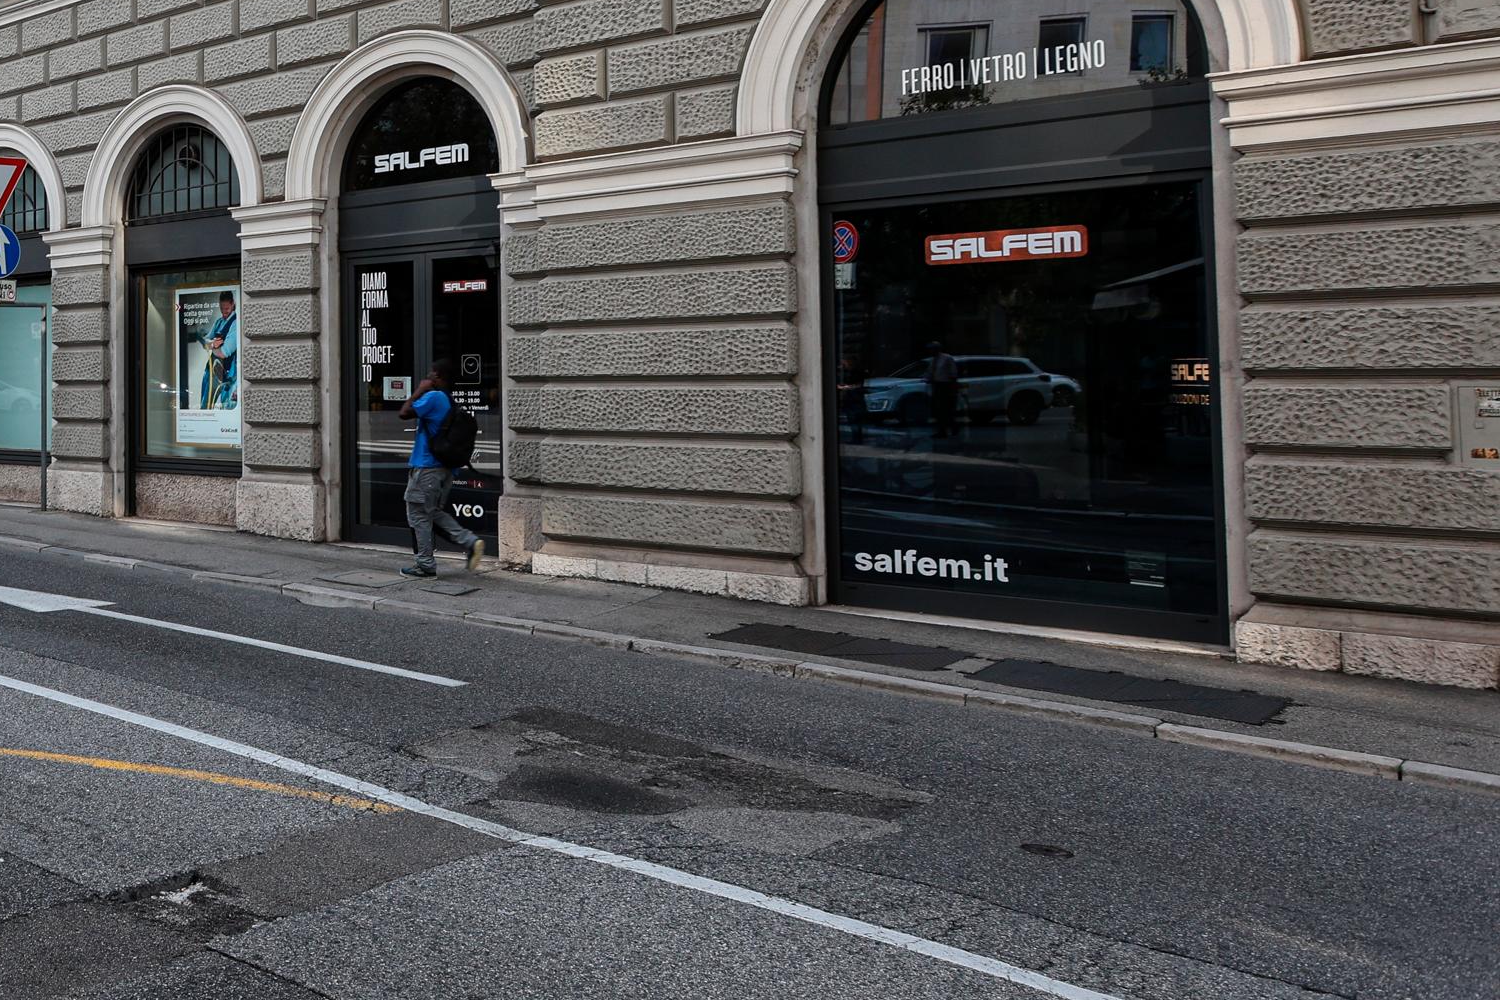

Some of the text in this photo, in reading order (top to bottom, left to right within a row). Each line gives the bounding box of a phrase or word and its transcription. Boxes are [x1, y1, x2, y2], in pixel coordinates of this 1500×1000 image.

[901, 62, 955, 96] FERRO
[970, 51, 1026, 86] VETRO
[1044, 39, 1106, 76] LEGNO
[374, 143, 469, 174] SALFEM
[930, 230, 1082, 261] SALFEM
[361, 271, 387, 290] DIAMO
[444, 281, 486, 292] SALFEM
[361, 290, 389, 309] FORMA
[361, 309, 372, 328] AL
[361, 327, 377, 345] TUO
[361, 364, 373, 382] TO
[854, 549, 1010, 583] salfem.it
